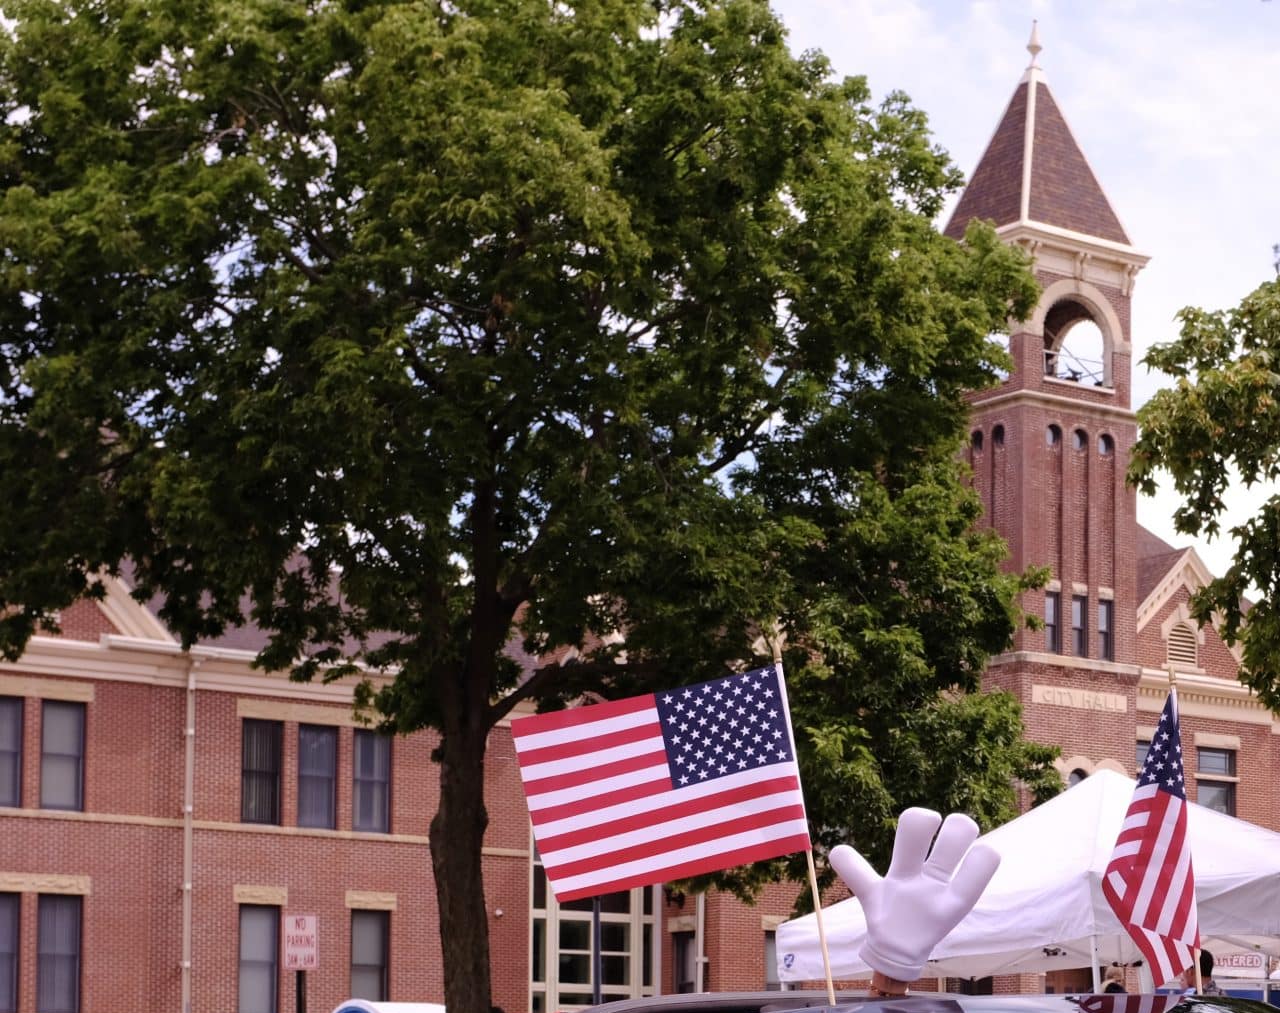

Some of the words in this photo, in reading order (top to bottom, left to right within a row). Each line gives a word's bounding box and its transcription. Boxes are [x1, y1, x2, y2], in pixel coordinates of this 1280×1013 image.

[1042, 687, 1076, 706] CITY
[1082, 692, 1125, 712] HALL
[295, 917, 306, 930] NO
[287, 934, 315, 947] PARKING
